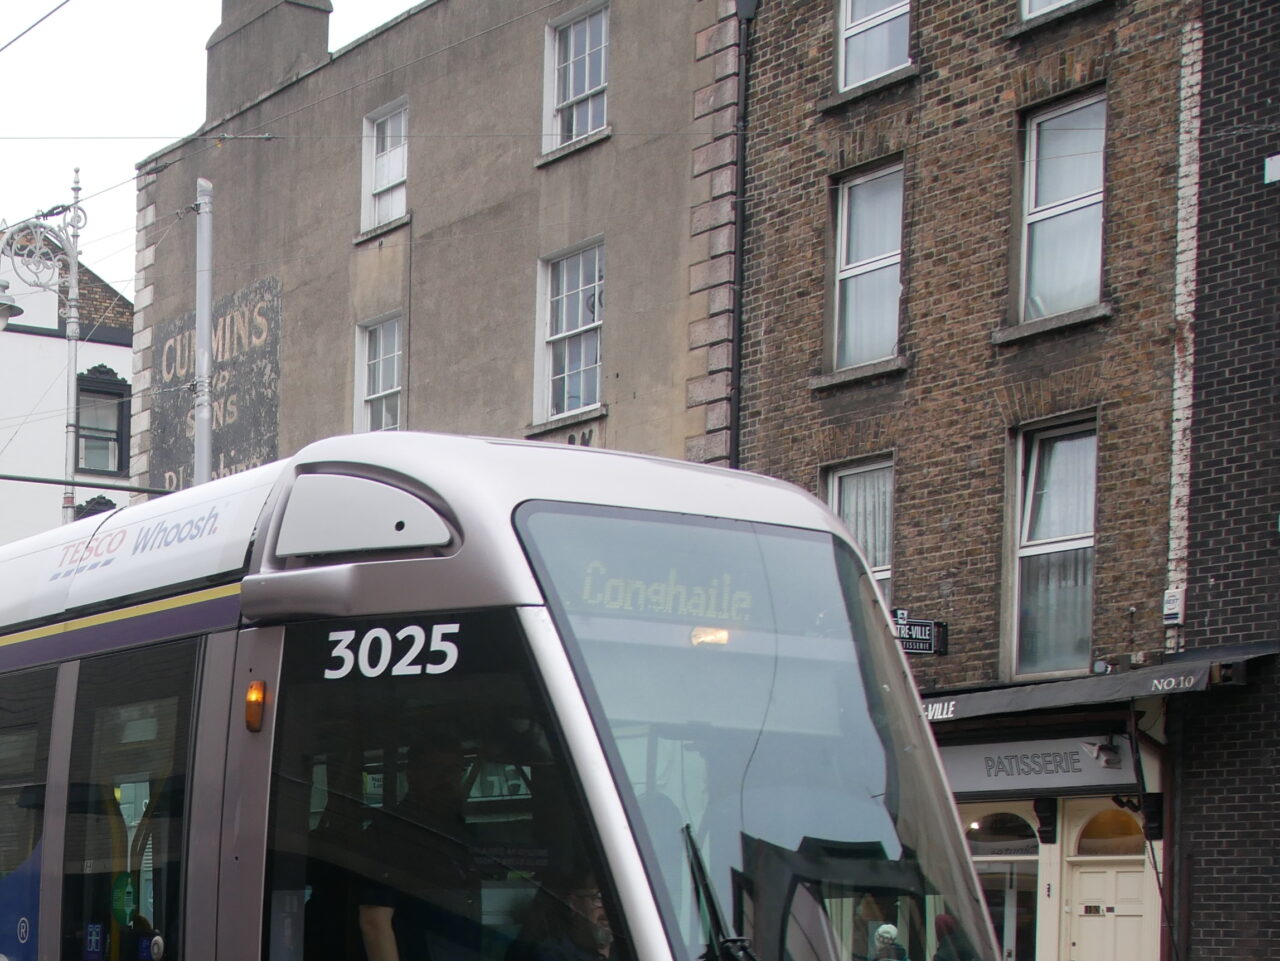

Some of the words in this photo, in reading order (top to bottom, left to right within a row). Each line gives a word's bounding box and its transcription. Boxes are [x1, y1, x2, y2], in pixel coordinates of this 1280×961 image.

[186, 394, 238, 438] SNS
[58, 529, 127, 568] TESCO
[323, 623, 460, 679] 3025
[984, 751, 1082, 777] PATISSERIE
